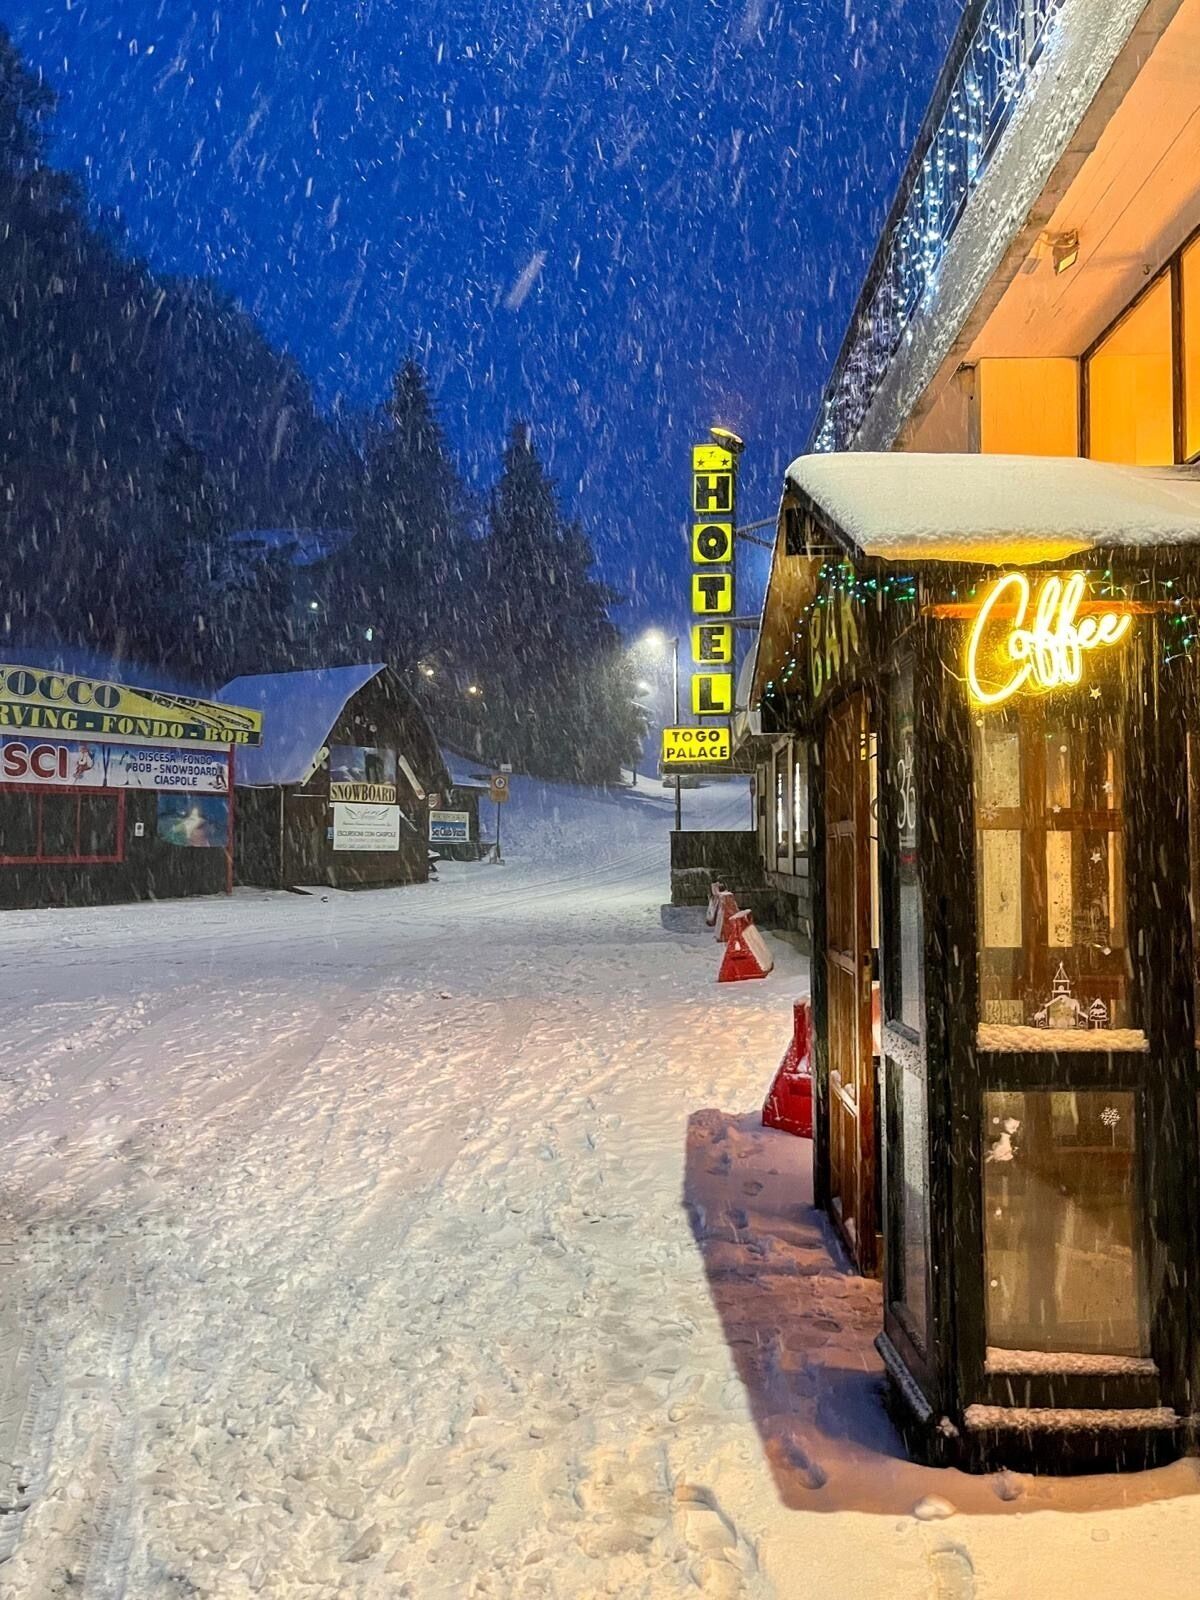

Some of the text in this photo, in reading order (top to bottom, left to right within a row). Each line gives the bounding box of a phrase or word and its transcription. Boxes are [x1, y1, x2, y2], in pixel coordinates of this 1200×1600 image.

[696, 476, 730, 711] HOTEL
[967, 571, 1132, 705] Coffee
[0, 669, 121, 709] OCCO
[102, 715, 184, 739] FONDO
[205, 727, 250, 744] BOB
[672, 730, 720, 743] TOGO
[3, 742, 69, 779] SCI
[138, 751, 212, 765] DISCESA FONDO
[666, 746, 727, 758] PALACE
[132, 763, 152, 773] BOB
[160, 764, 217, 777] SNOWBOARD
[154, 775, 198, 786] CIASPOLE
[331, 784, 395, 802] SNOWBOARD
